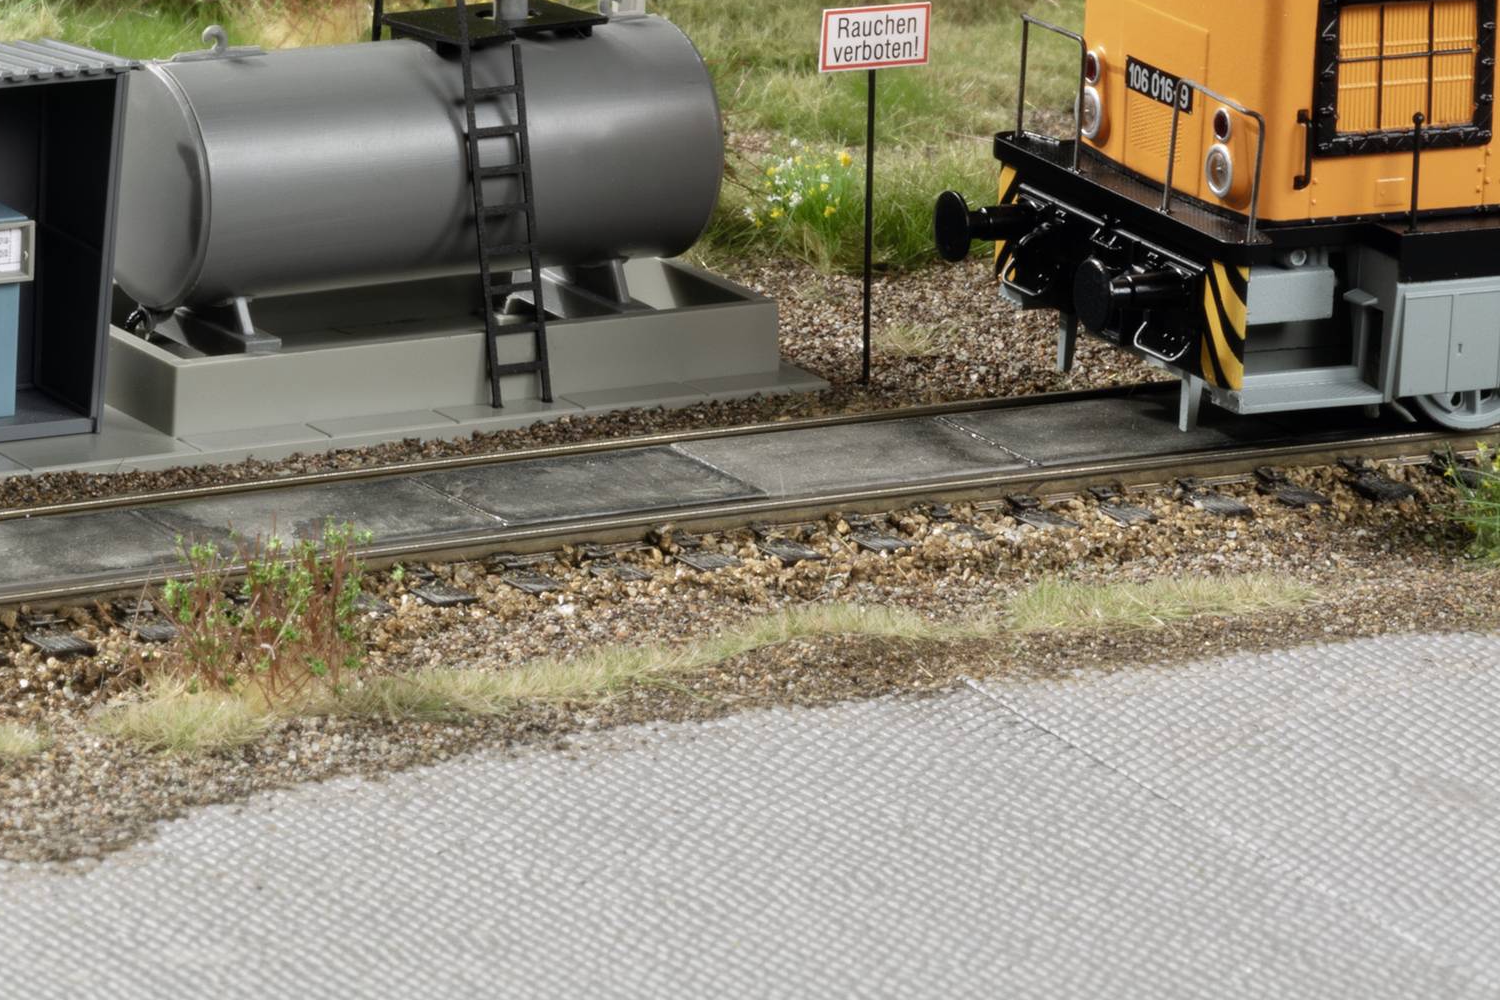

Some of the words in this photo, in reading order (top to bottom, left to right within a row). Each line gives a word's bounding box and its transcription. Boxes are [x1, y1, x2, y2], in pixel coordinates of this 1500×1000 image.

[838, 13, 917, 38] Rauchen
[833, 36, 918, 63] verboten!
[1129, 62, 1149, 93] 106
